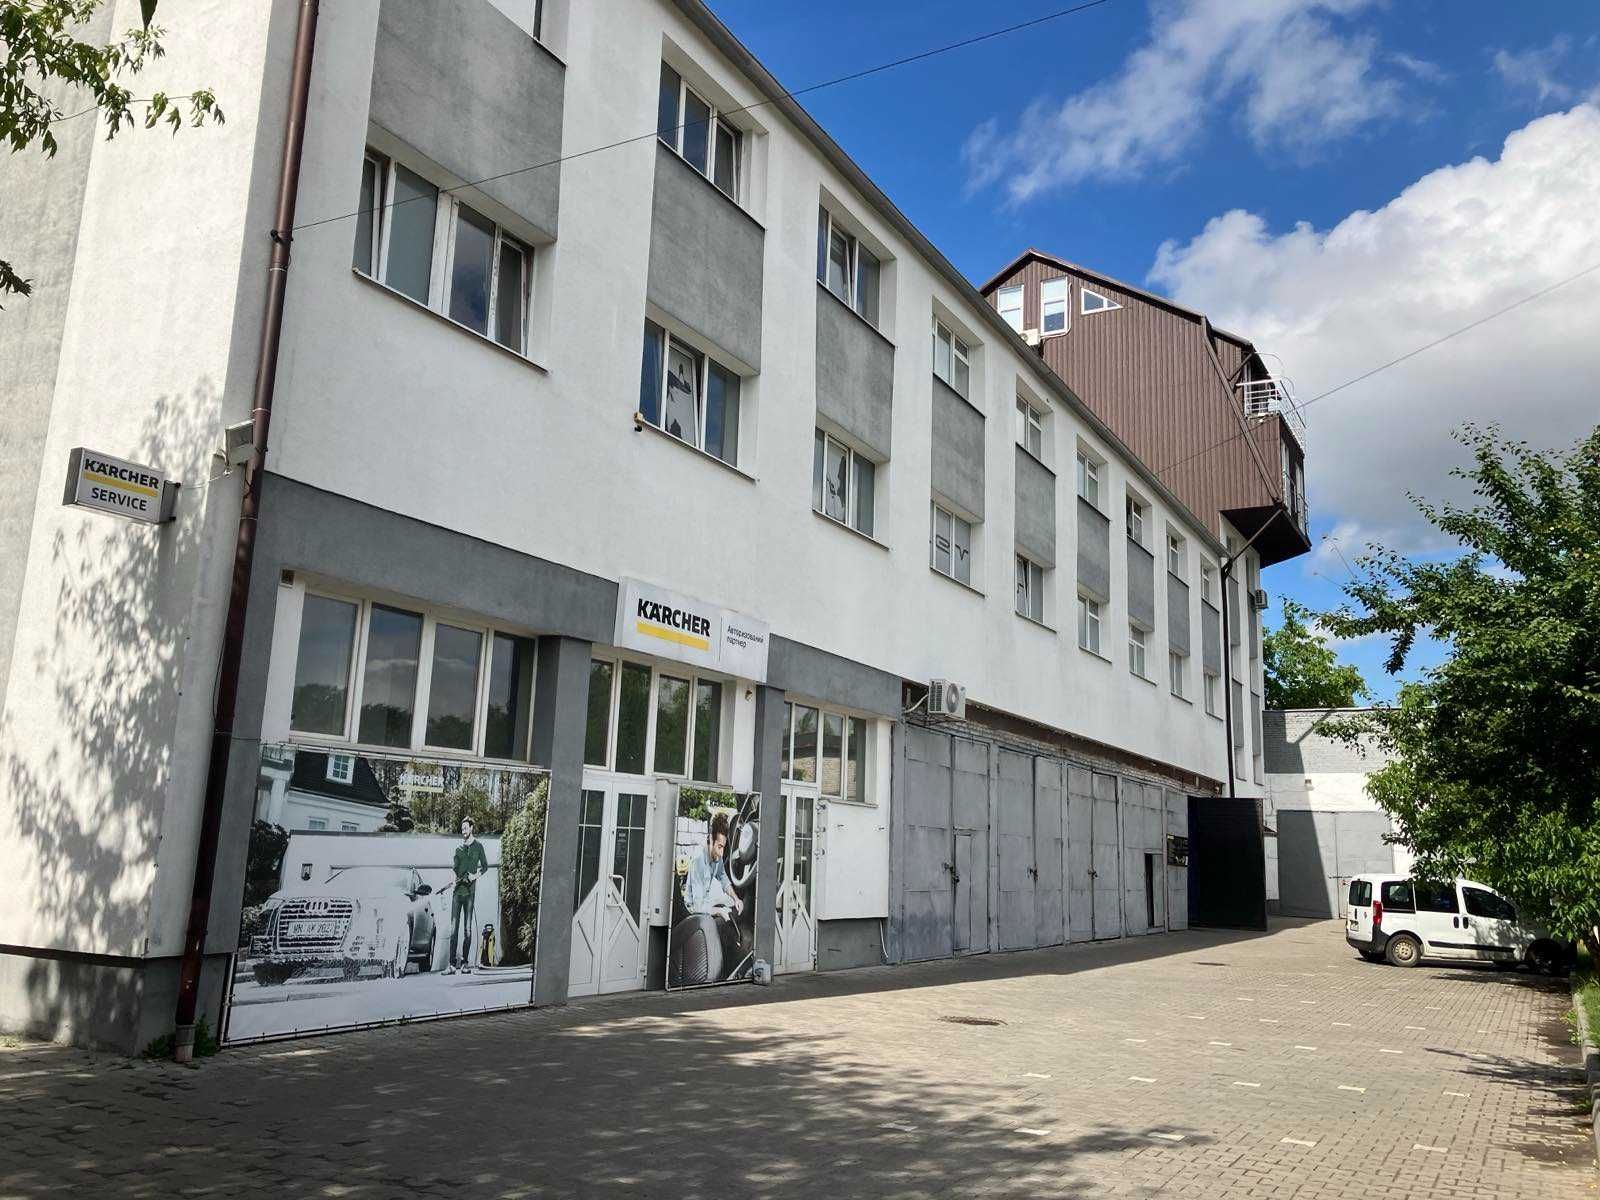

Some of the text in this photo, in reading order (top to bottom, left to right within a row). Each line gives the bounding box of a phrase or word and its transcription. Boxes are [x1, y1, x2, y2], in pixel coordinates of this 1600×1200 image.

[84, 459, 159, 489] KÄRCHER
[91, 487, 147, 511] SERVICE
[637, 598, 711, 637] KÄRCHER
